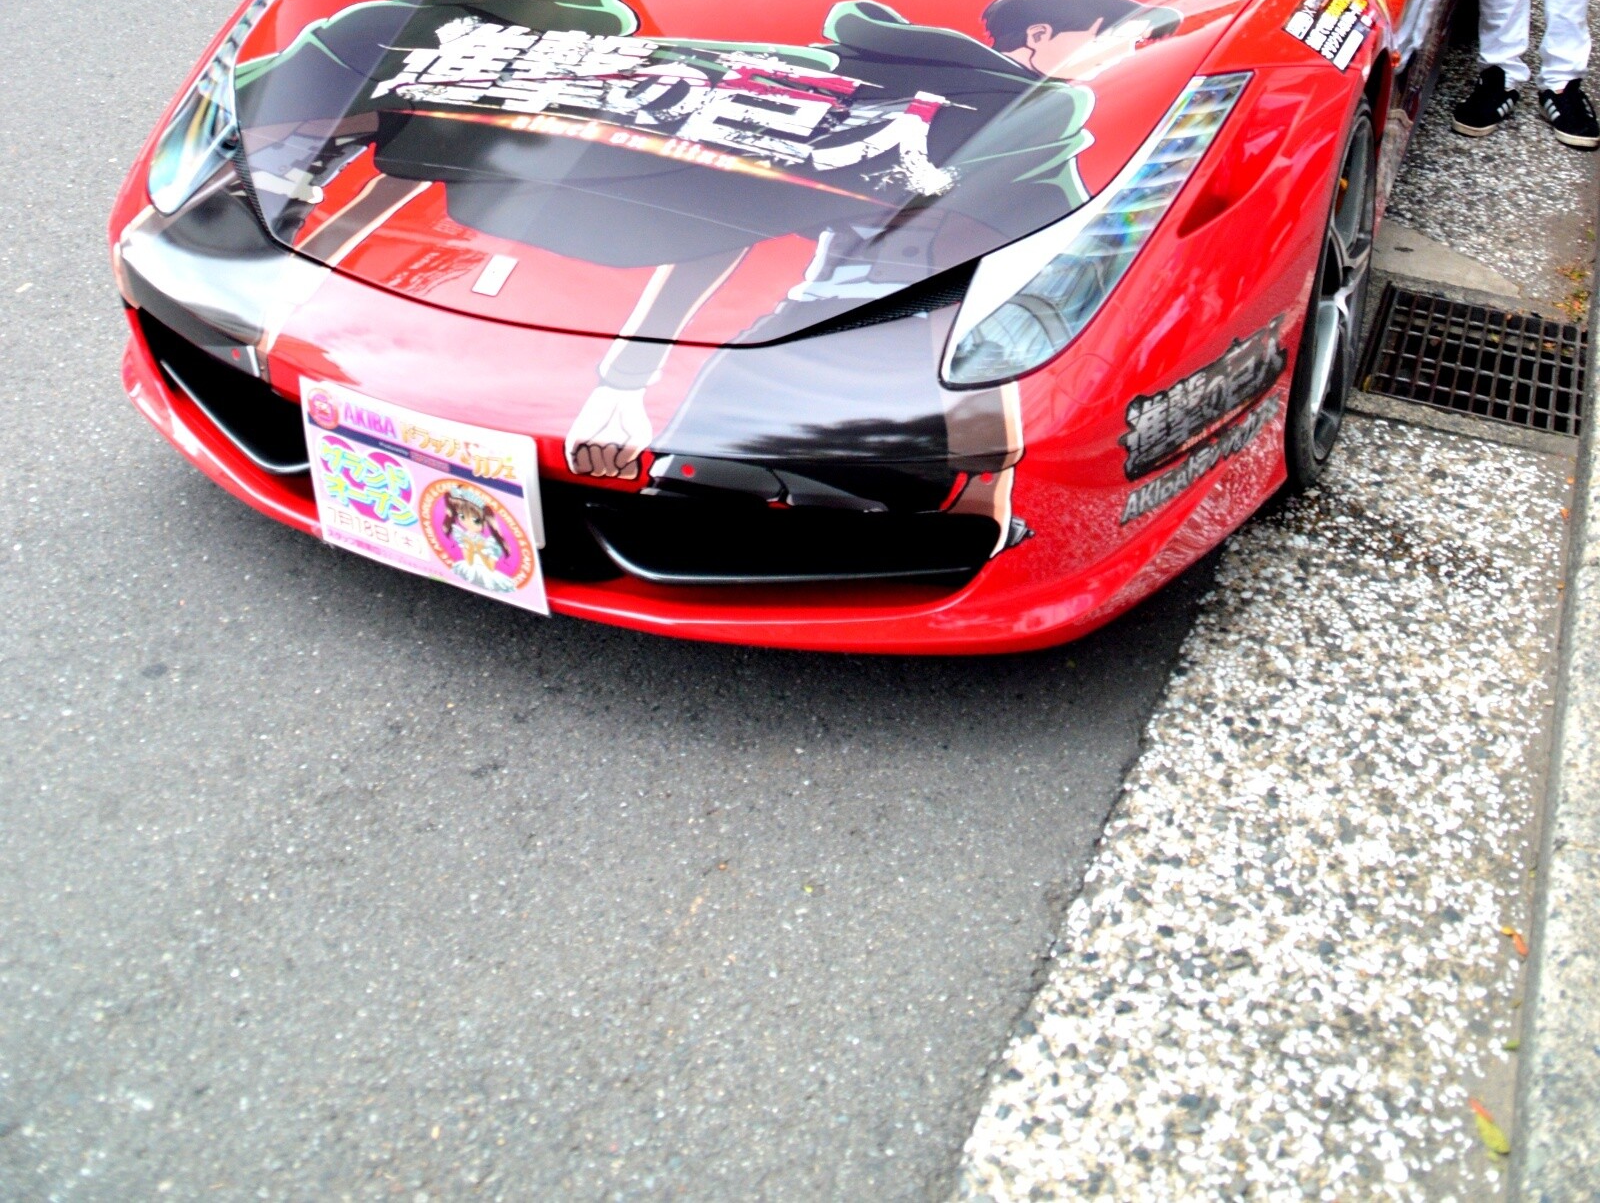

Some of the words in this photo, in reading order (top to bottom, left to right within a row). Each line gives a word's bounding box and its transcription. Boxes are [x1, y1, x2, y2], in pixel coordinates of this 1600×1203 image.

[369, 15, 960, 196] 進撃の巨人
[344, 401, 398, 439] AKIBA
